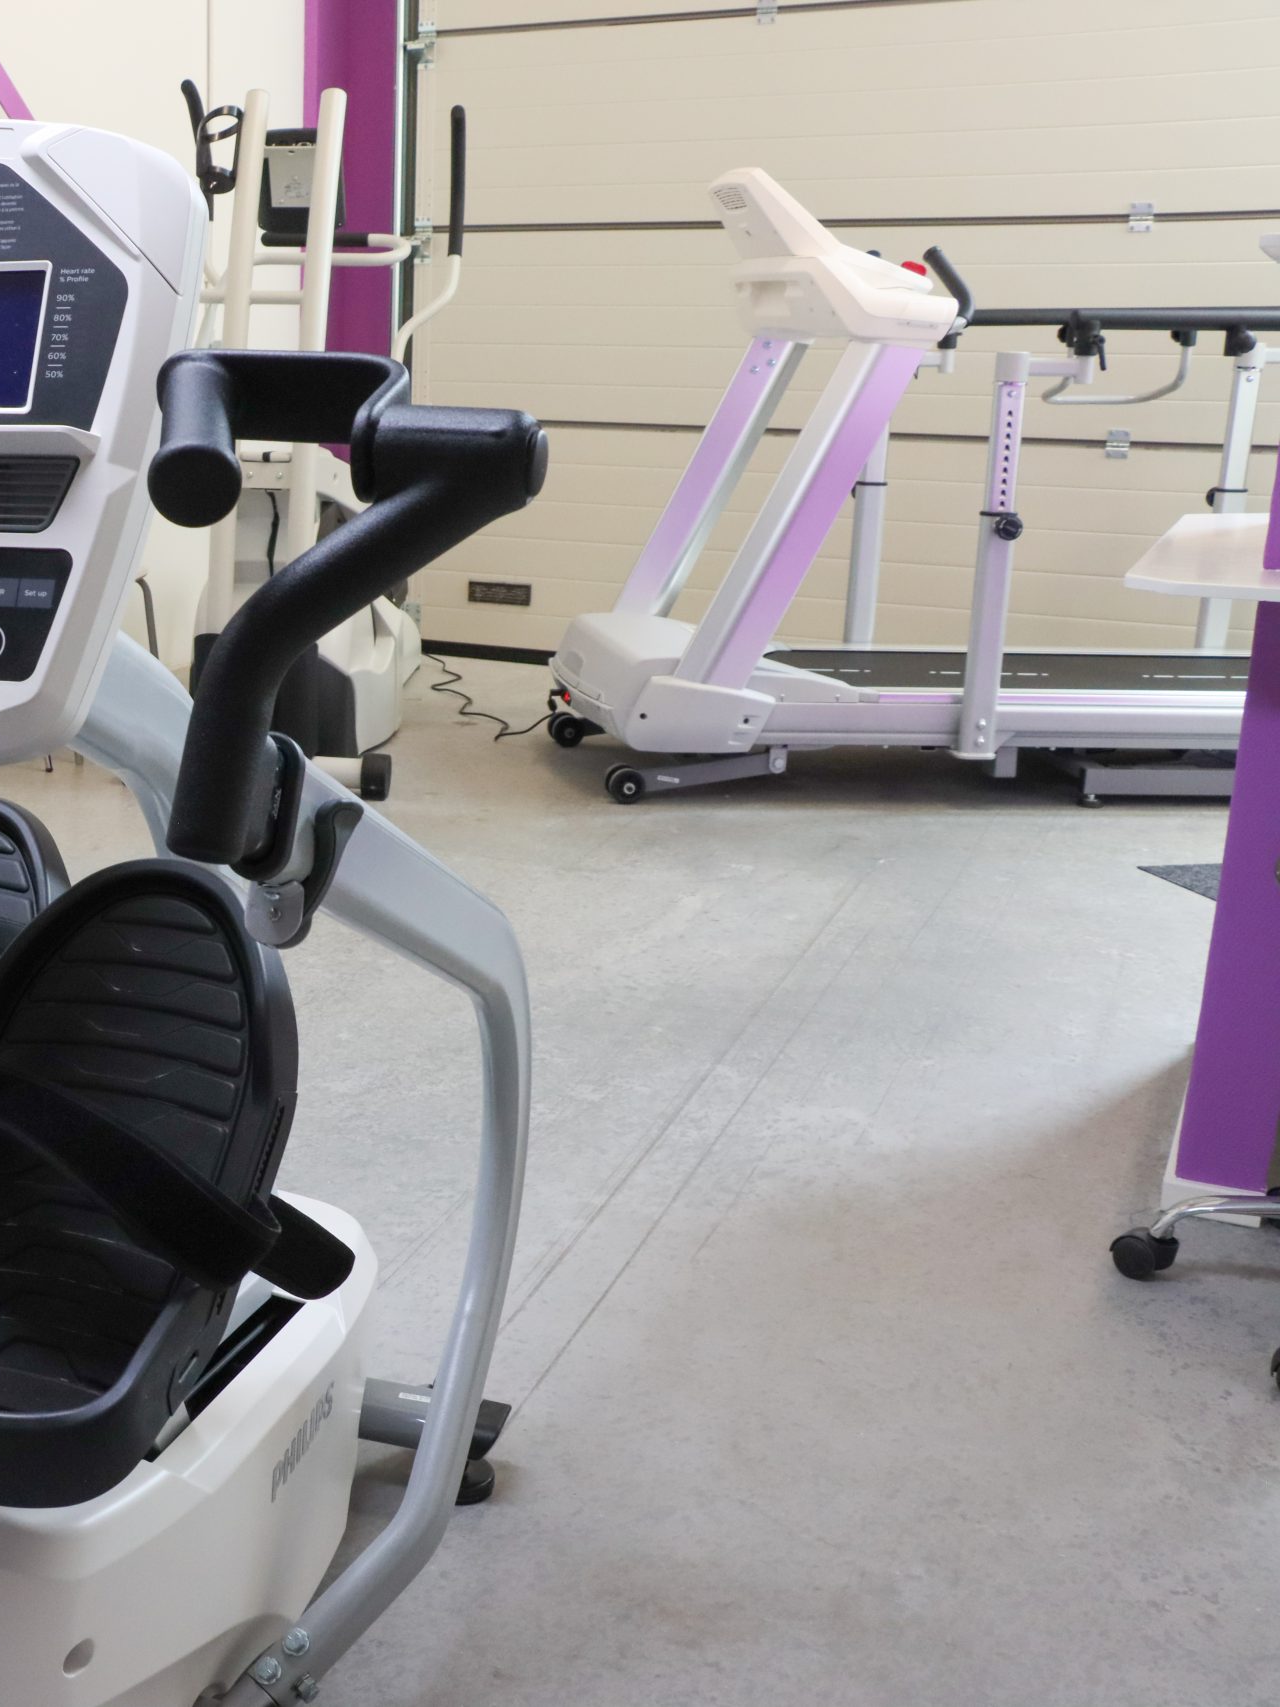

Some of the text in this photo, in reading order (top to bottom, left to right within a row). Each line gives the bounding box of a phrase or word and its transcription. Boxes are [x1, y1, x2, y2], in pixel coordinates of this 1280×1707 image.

[56, 294, 75, 302] 90%
[53, 314, 72, 322] 80%
[51, 333, 69, 341] 70%
[47, 352, 66, 360] 60%
[45, 370, 64, 378] 50%
[271, 1381, 335, 1503] PHILIPS
